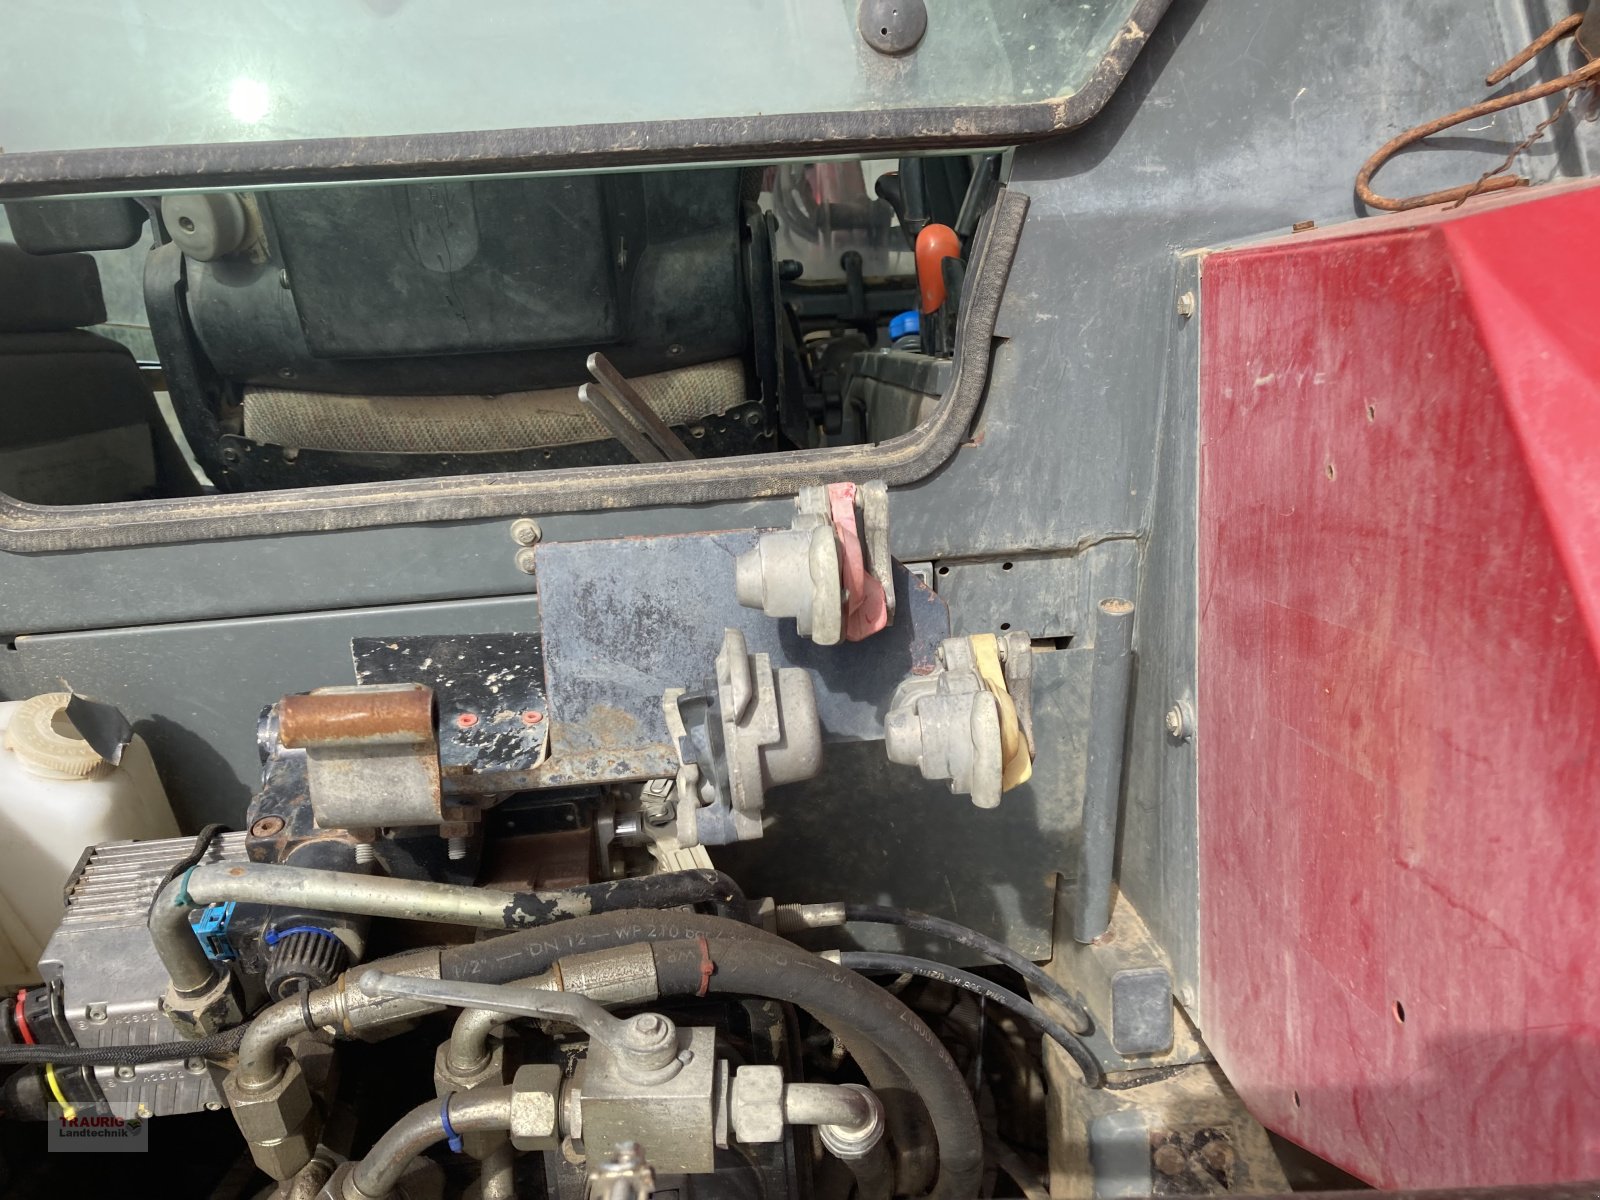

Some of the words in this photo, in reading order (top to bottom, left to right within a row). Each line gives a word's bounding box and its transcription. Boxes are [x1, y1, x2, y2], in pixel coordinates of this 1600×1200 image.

[529, 941, 559, 957] DN
[568, 933, 587, 948] 12
[615, 925, 641, 939] WP
[647, 923, 679, 938] 210
